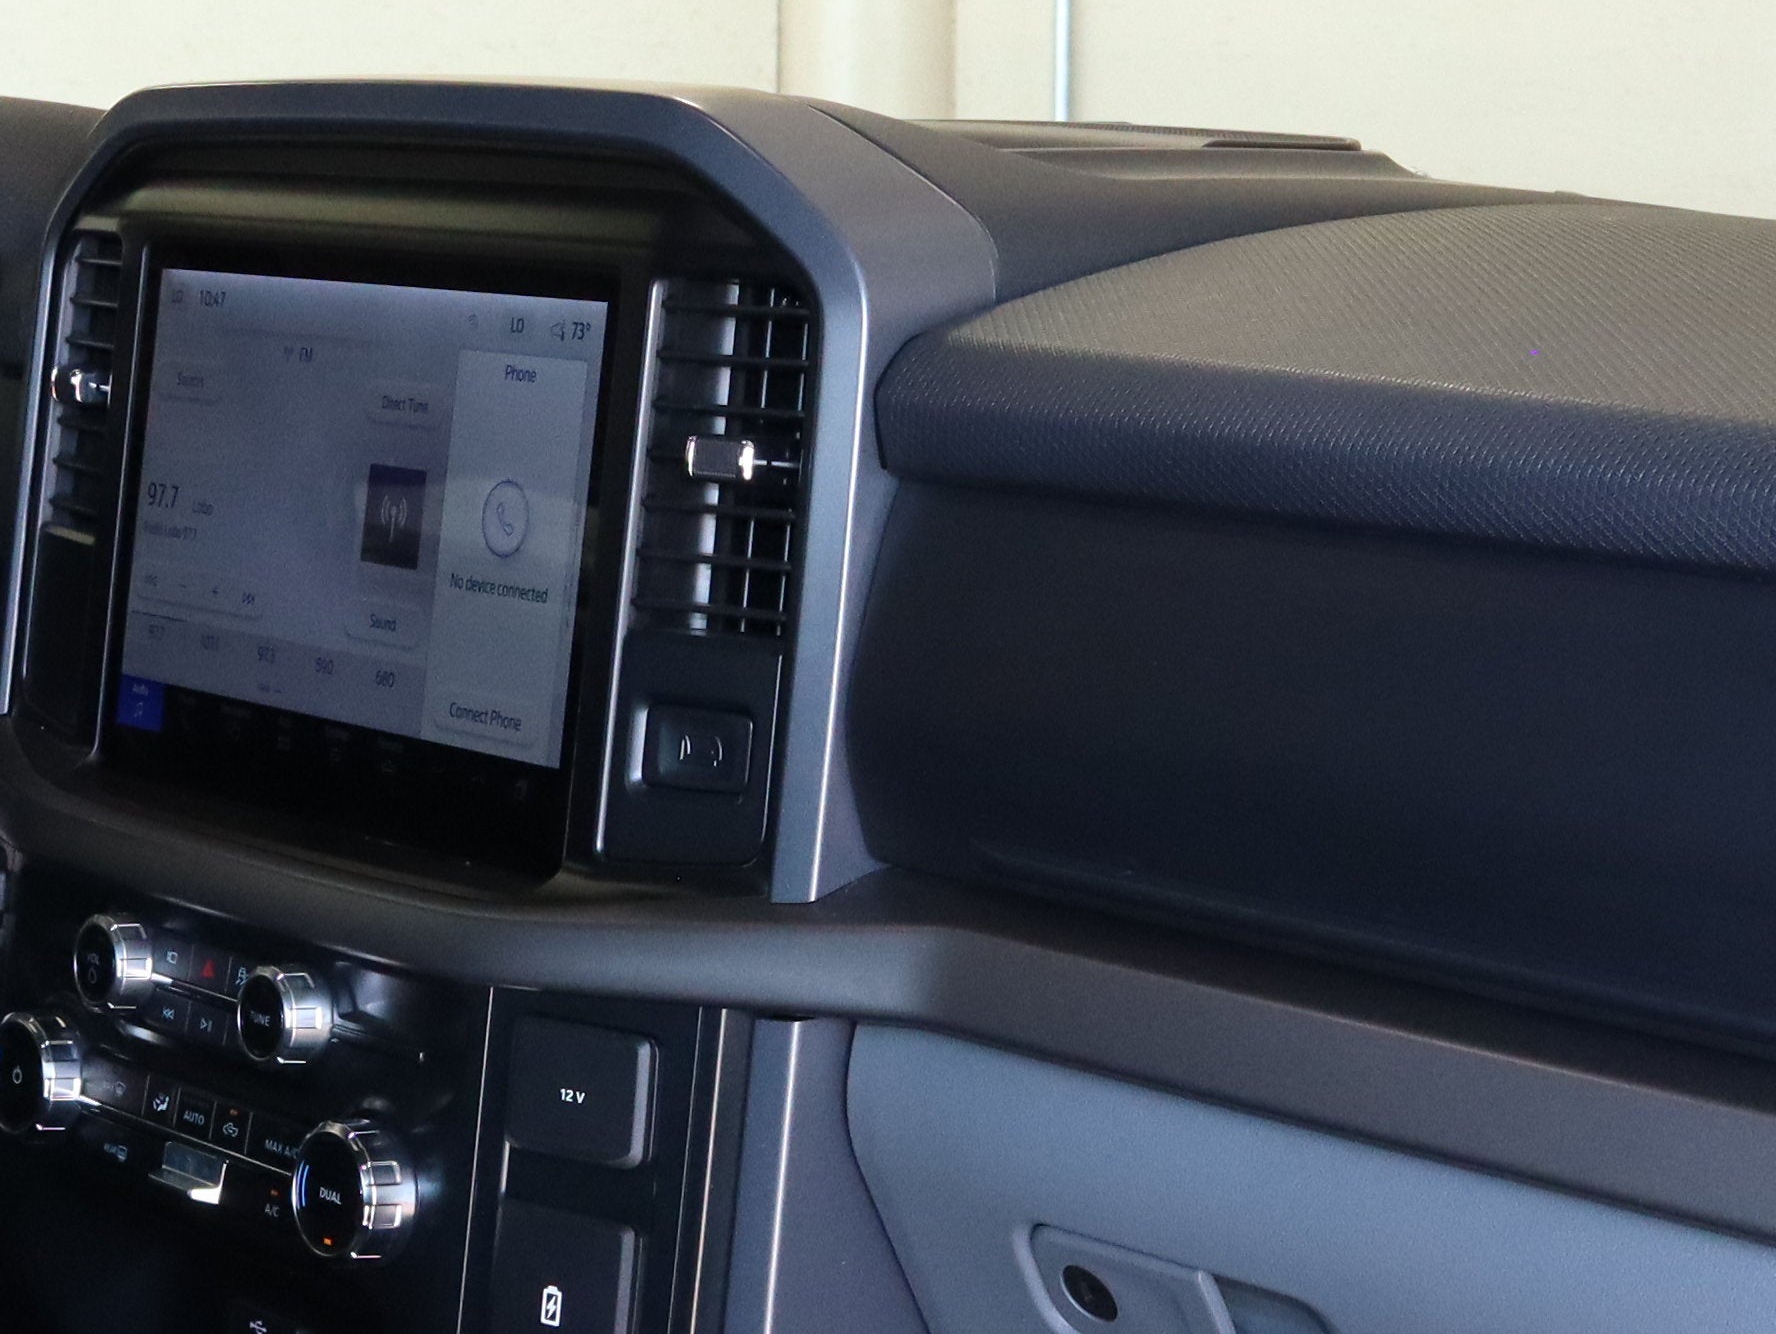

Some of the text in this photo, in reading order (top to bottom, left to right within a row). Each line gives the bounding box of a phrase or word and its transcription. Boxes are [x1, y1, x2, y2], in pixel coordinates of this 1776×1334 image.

[510, 317, 525, 334] LO
[505, 365, 537, 384] Phone
[147, 482, 180, 509] 97.7
[450, 573, 549, 605] No device connected
[449, 701, 523, 733] Connect Phone
[560, 1088, 574, 1102] 12
[183, 1109, 206, 1127] AUTO
[319, 1185, 342, 1206] DUAL
[264, 1202, 280, 1218] A/C
